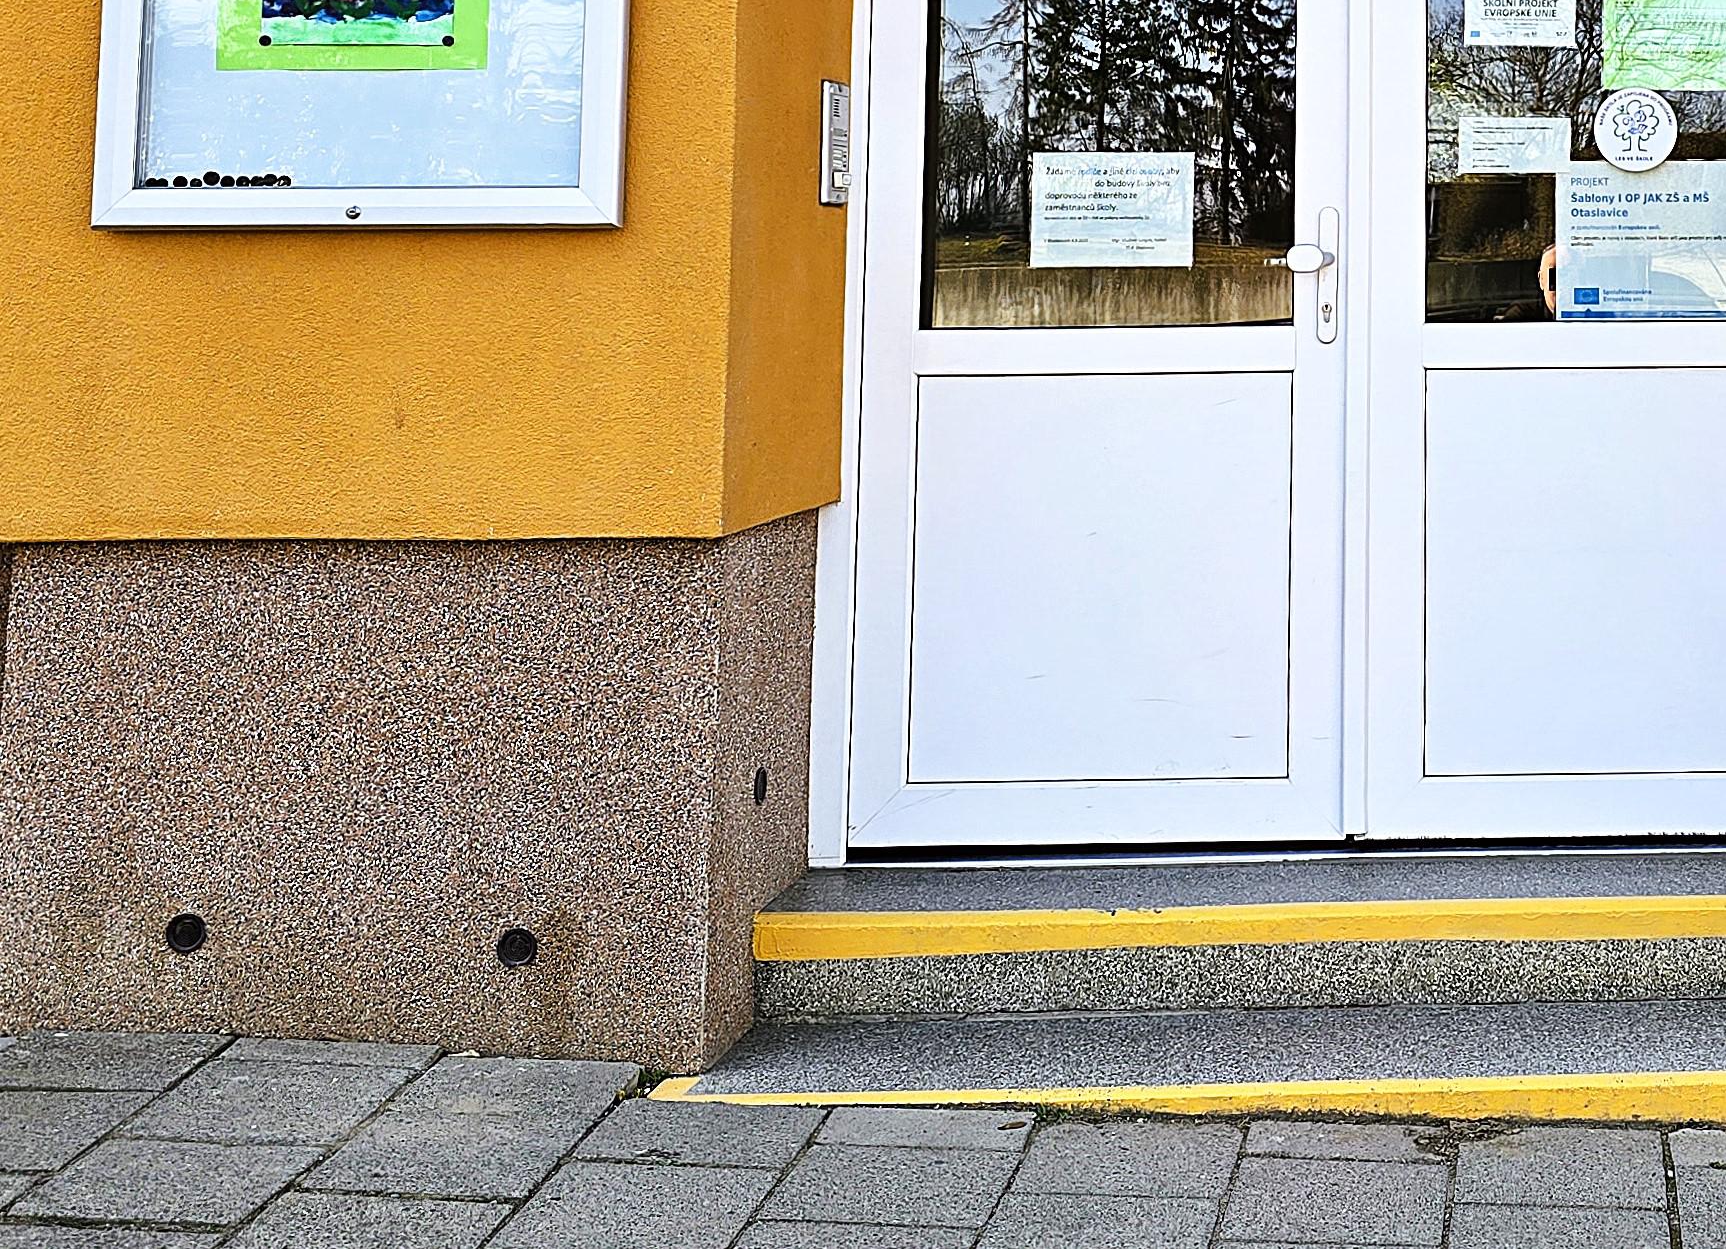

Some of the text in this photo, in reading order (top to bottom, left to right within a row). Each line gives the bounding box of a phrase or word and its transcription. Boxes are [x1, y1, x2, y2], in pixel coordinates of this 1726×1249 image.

[1484, 7, 1557, 18] EVROPSKÉ UNIE
[1106, 179, 1136, 188] budovy
[1571, 177, 1609, 188] PROJEKT
[1571, 192, 1614, 205] Šablony
[1625, 194, 1641, 203] OP
[1643, 193, 1664, 205] JAK
[1665, 192, 1680, 203] ZŠ
[1683, 195, 1690, 203] a
[1693, 191, 1710, 203] MŠ
[1571, 207, 1629, 218] Otaslavice
